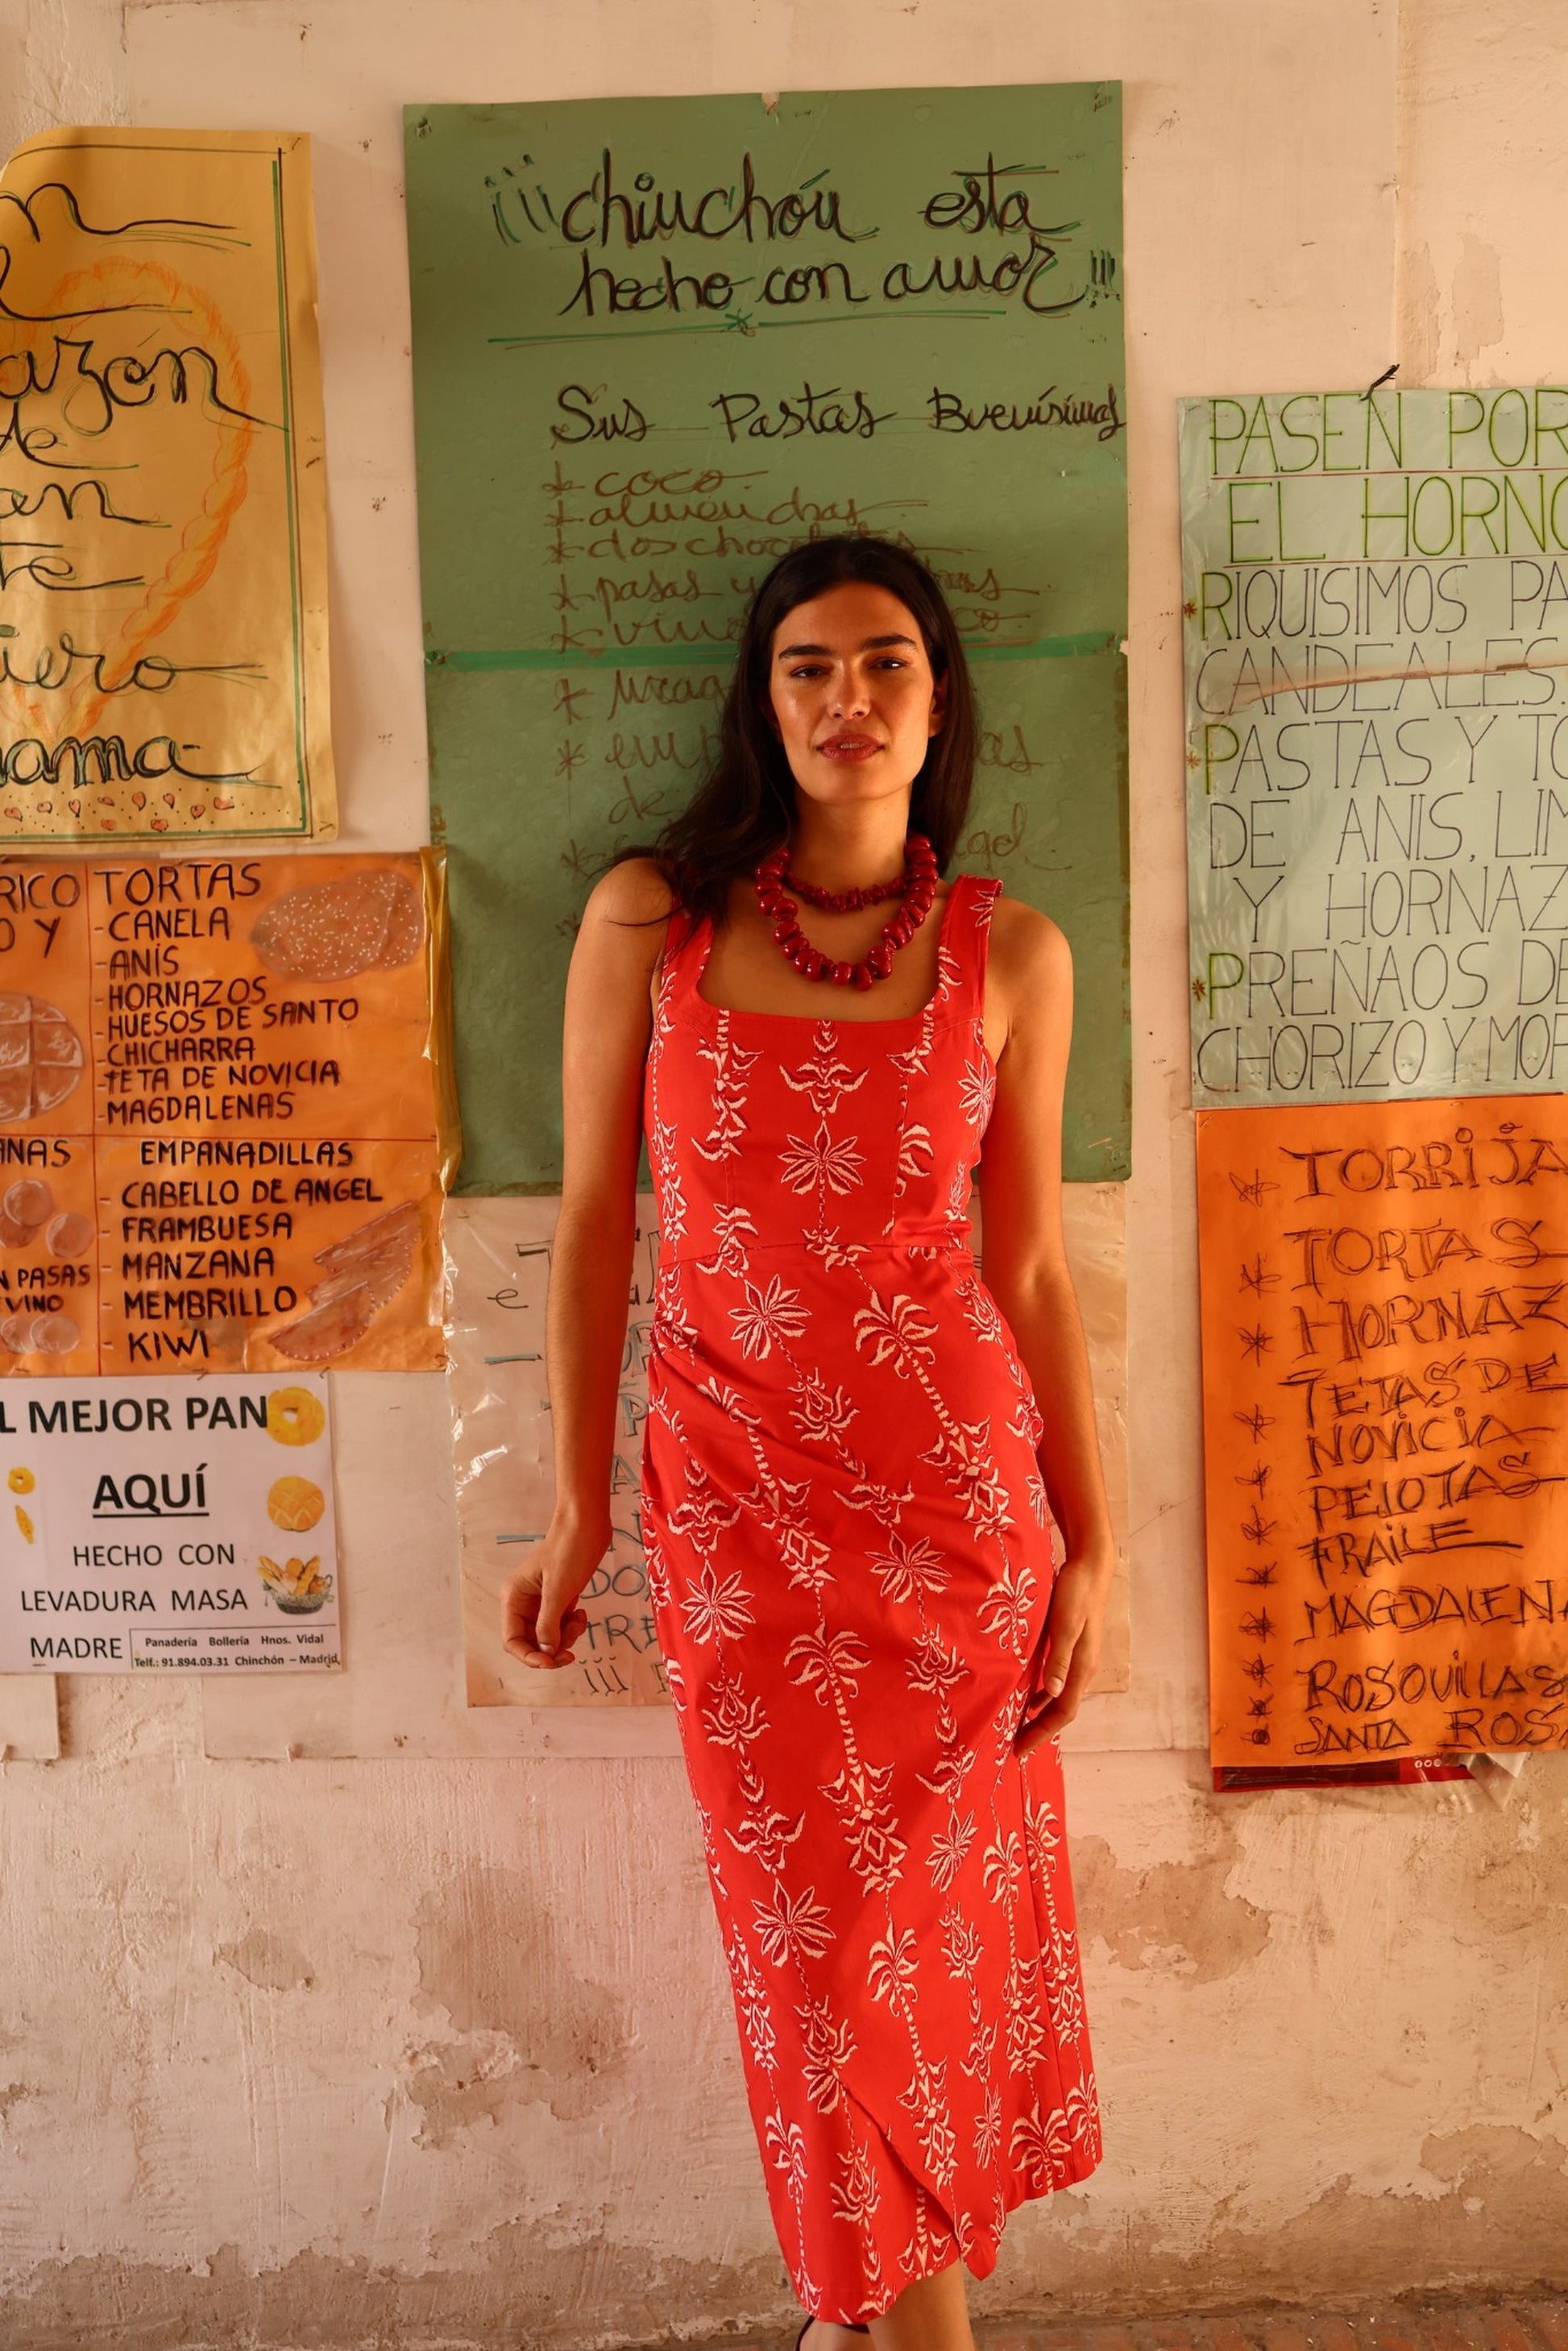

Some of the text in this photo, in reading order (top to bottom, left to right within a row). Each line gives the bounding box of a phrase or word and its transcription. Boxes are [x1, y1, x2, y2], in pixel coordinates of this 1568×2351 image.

[559, 249, 753, 316] hecho
[756, 259, 868, 305] con
[551, 384, 657, 443] Sus
[712, 382, 897, 442] Pastas
[1209, 388, 1568, 475] PASEN POR
[1228, 479, 1326, 564] EL
[597, 570, 721, 620] pasas
[1201, 564, 1468, 641] RIQUISIMOS
[1205, 718, 1433, 795] PASTAS
[1454, 715, 1498, 784] Y
[1209, 799, 1289, 869] DE
[93, 862, 262, 906] TORTAS
[107, 906, 230, 941] CANELA
[1233, 865, 1568, 943] Y HORNAZ
[34, 916, 61, 959] Y
[108, 976, 267, 1012] HORNAZOS
[1208, 939, 1489, 1019] PREÑAOS
[108, 997, 359, 1041] HUESOS DE SANTO
[106, 1036, 255, 1068] CHICHARRA
[1197, 1018, 1426, 1093] CHORIZO
[1442, 1016, 1477, 1083] Y
[183, 1065, 217, 1088] DE
[229, 1059, 340, 1087] NOVICIA
[107, 1091, 294, 1125] MAGDALENAS
[140, 1140, 354, 1167] EMPANADILLAS
[121, 1177, 384, 1209] CABELLO DE ANGEL
[122, 1212, 293, 1243] FRAMBUESA
[18, 1264, 91, 1289] PASAS
[122, 1246, 275, 1281] MANZANA
[1284, 1217, 1563, 1297] TORTAS
[5, 1294, 64, 1313] VINO
[124, 1285, 297, 1320] MEMBRILLO
[128, 1330, 210, 1362] KIWI
[1474, 1353, 1565, 1393] DE
[28, 1398, 172, 1434] MEJOR
[186, 1395, 268, 1431] PAN
[93, 1463, 208, 1514] AQUÍ
[73, 1543, 235, 1567] HECHO CON
[21, 1588, 248, 1611] LEVADURA MASA
[30, 1636, 123, 1660] MADRE
[145, 1633, 324, 1648] Panadería Bollería Hnos. Vidal
[161, 1656, 229, 1668] 91.894.03.31
[234, 1654, 284, 1666] Chinchón
[1294, 1703, 1568, 1756] SANTA ROS
